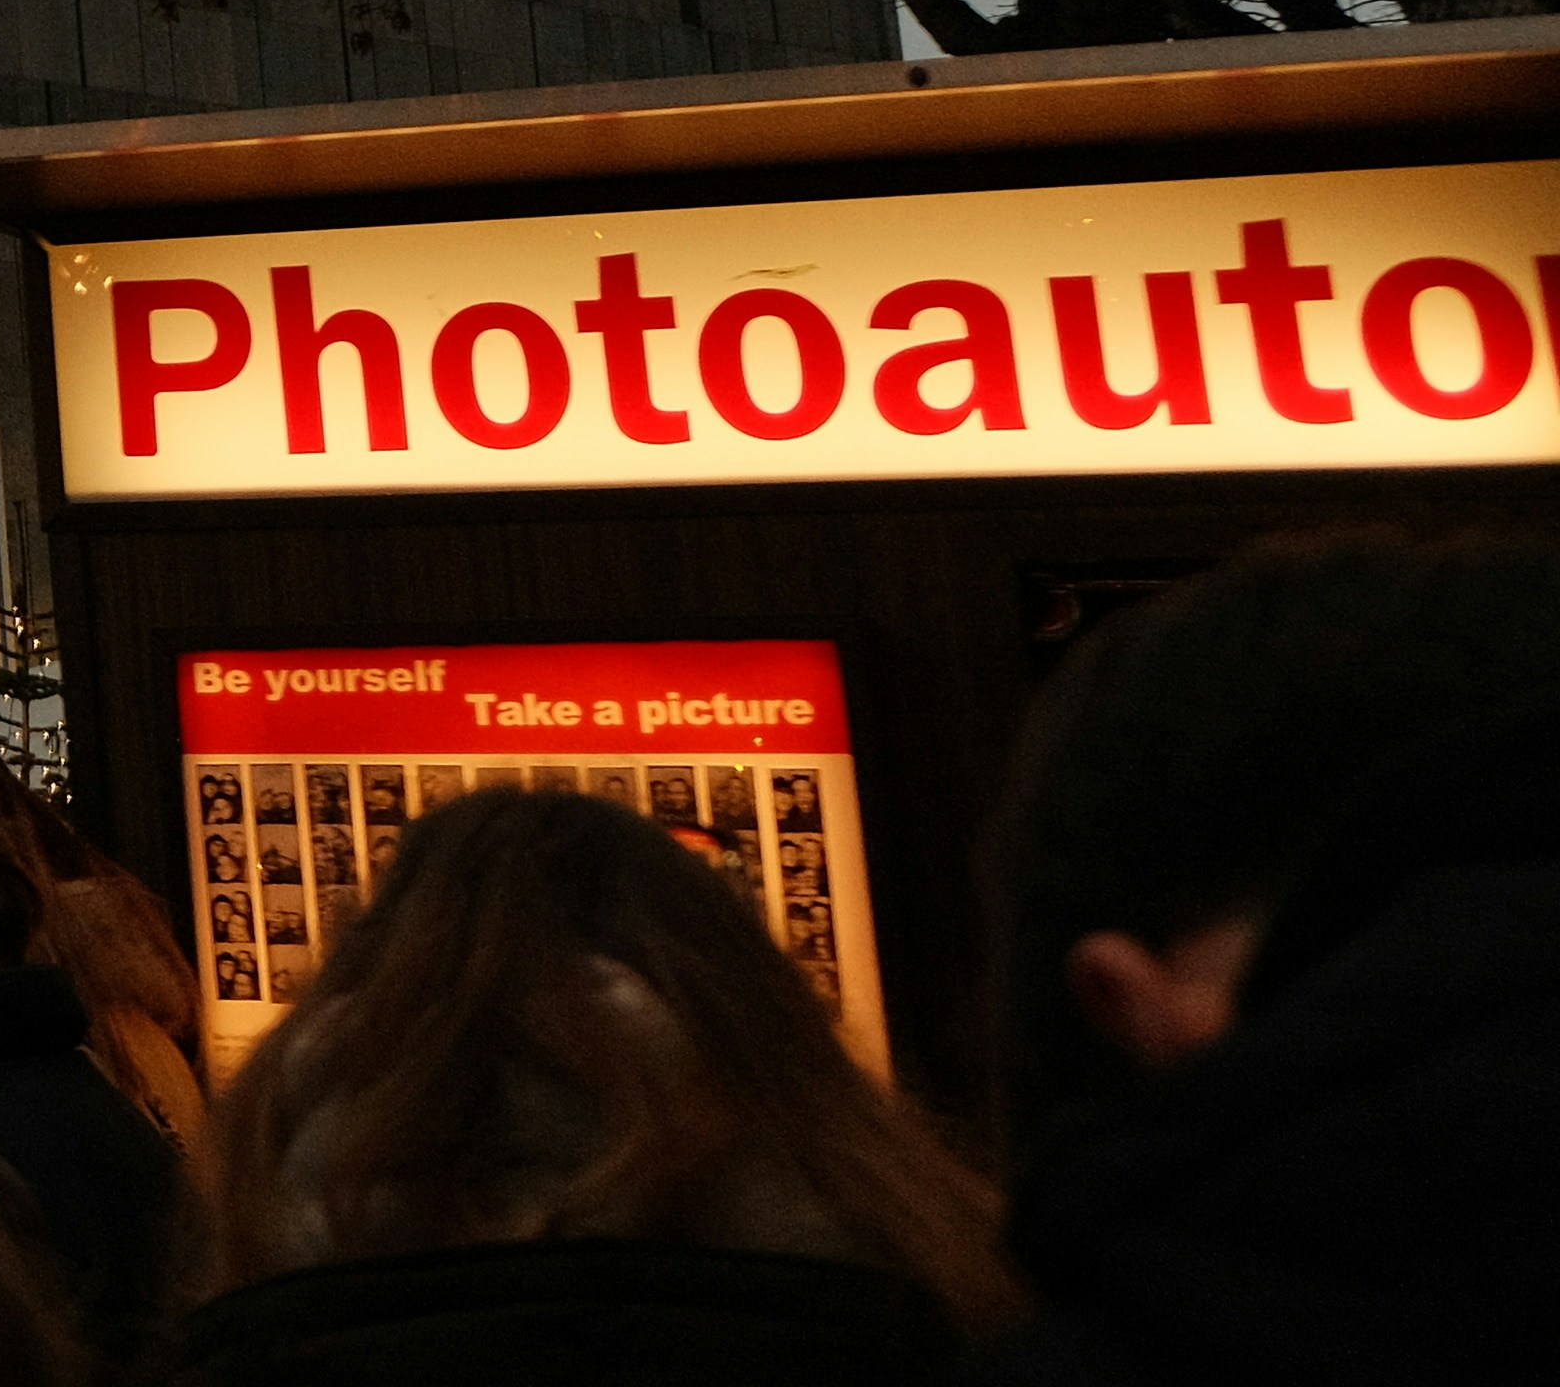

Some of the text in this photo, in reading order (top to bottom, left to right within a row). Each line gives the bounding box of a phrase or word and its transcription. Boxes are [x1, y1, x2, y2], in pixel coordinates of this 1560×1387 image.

[113, 217, 1560, 456] Photoauto
[192, 659, 447, 701] Be yourself
[464, 691, 814, 733] Take a picture
